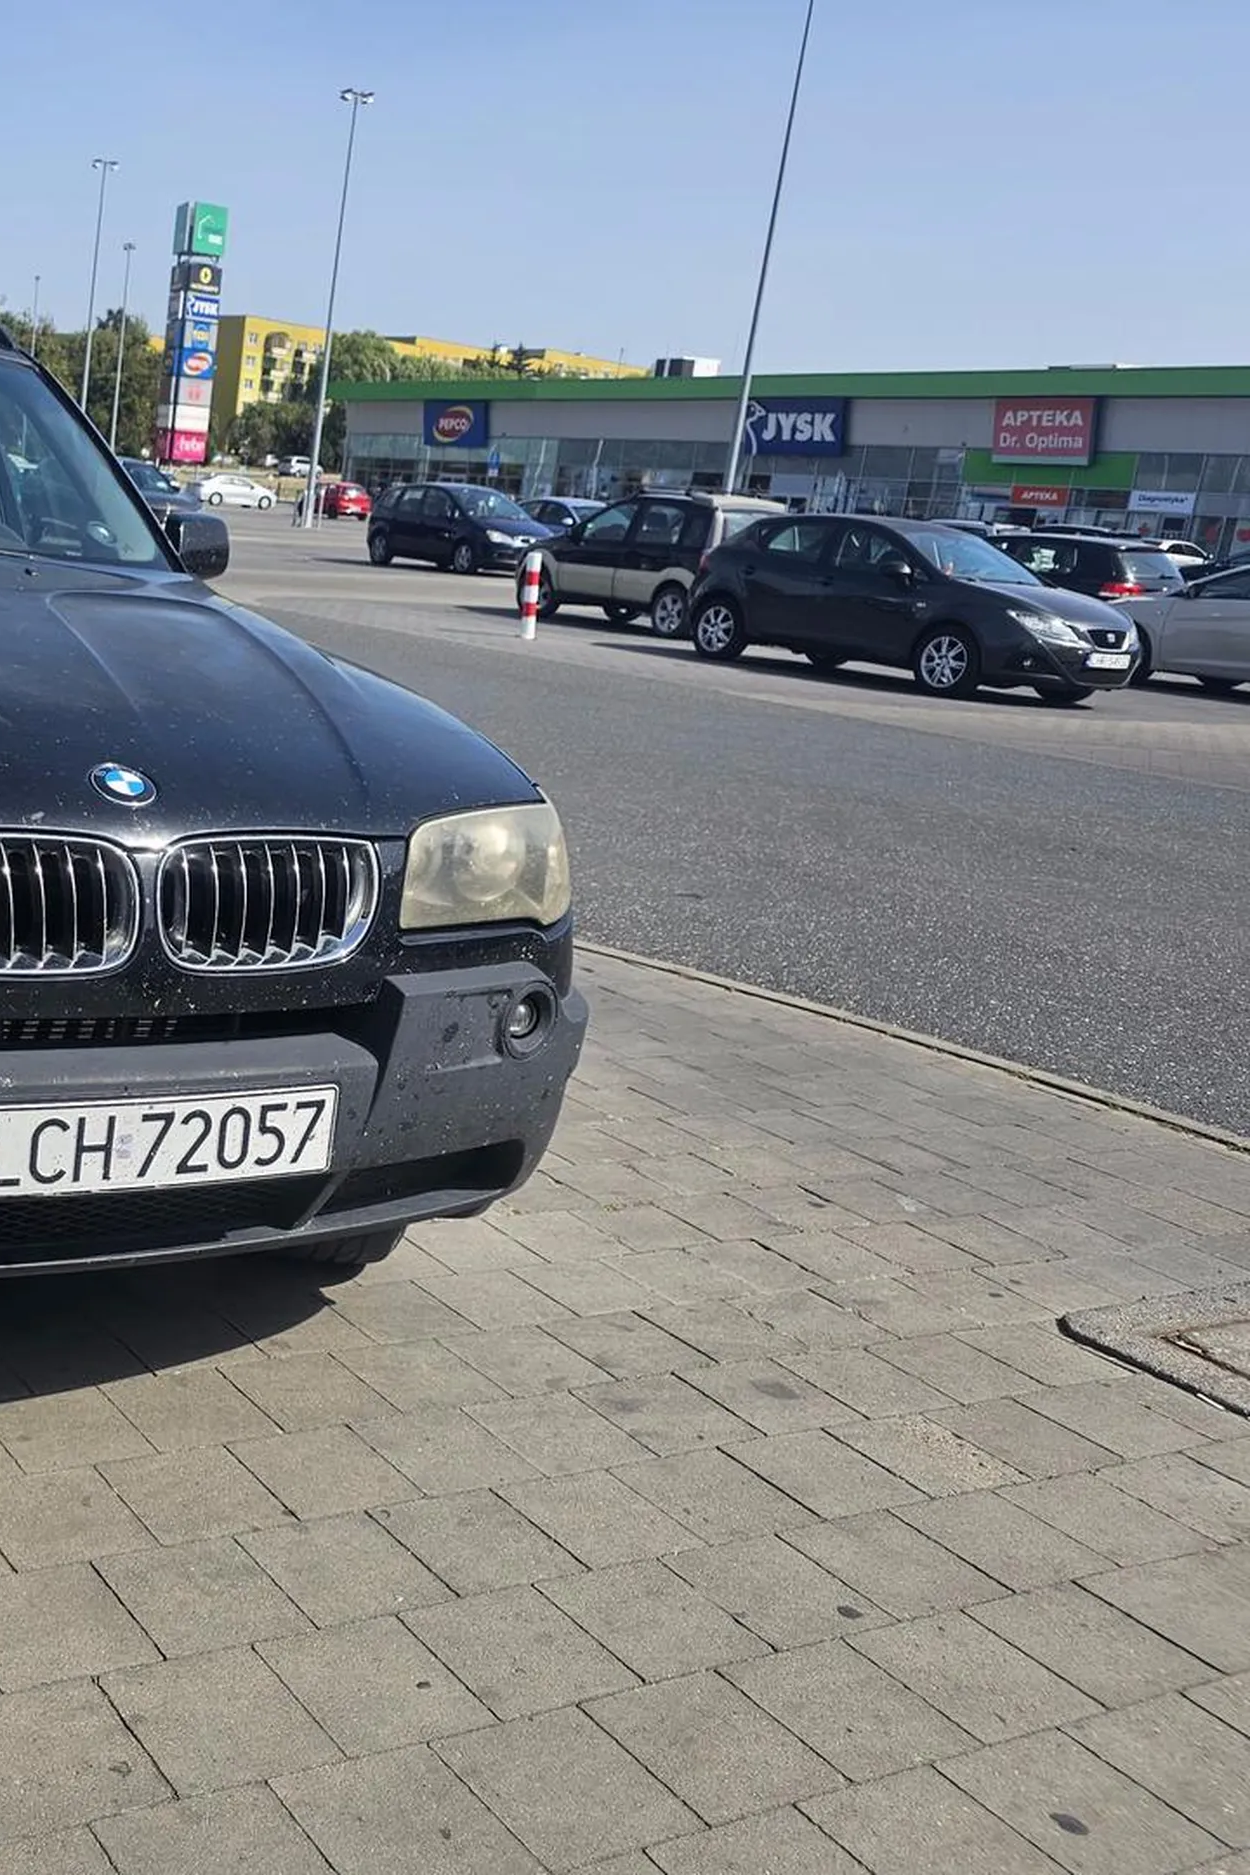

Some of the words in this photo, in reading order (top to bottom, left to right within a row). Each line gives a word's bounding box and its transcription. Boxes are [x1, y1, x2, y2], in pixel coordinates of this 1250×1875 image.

[438, 417, 469, 431] PEPCO
[762, 412, 836, 442] JYSK
[1002, 409, 1083, 427] APTEKA
[999, 432, 1021, 448] Dr.
[1025, 432, 1083, 453] Optima
[1020, 491, 1059, 501] APTEKA
[136, 1098, 328, 1178] 72057
